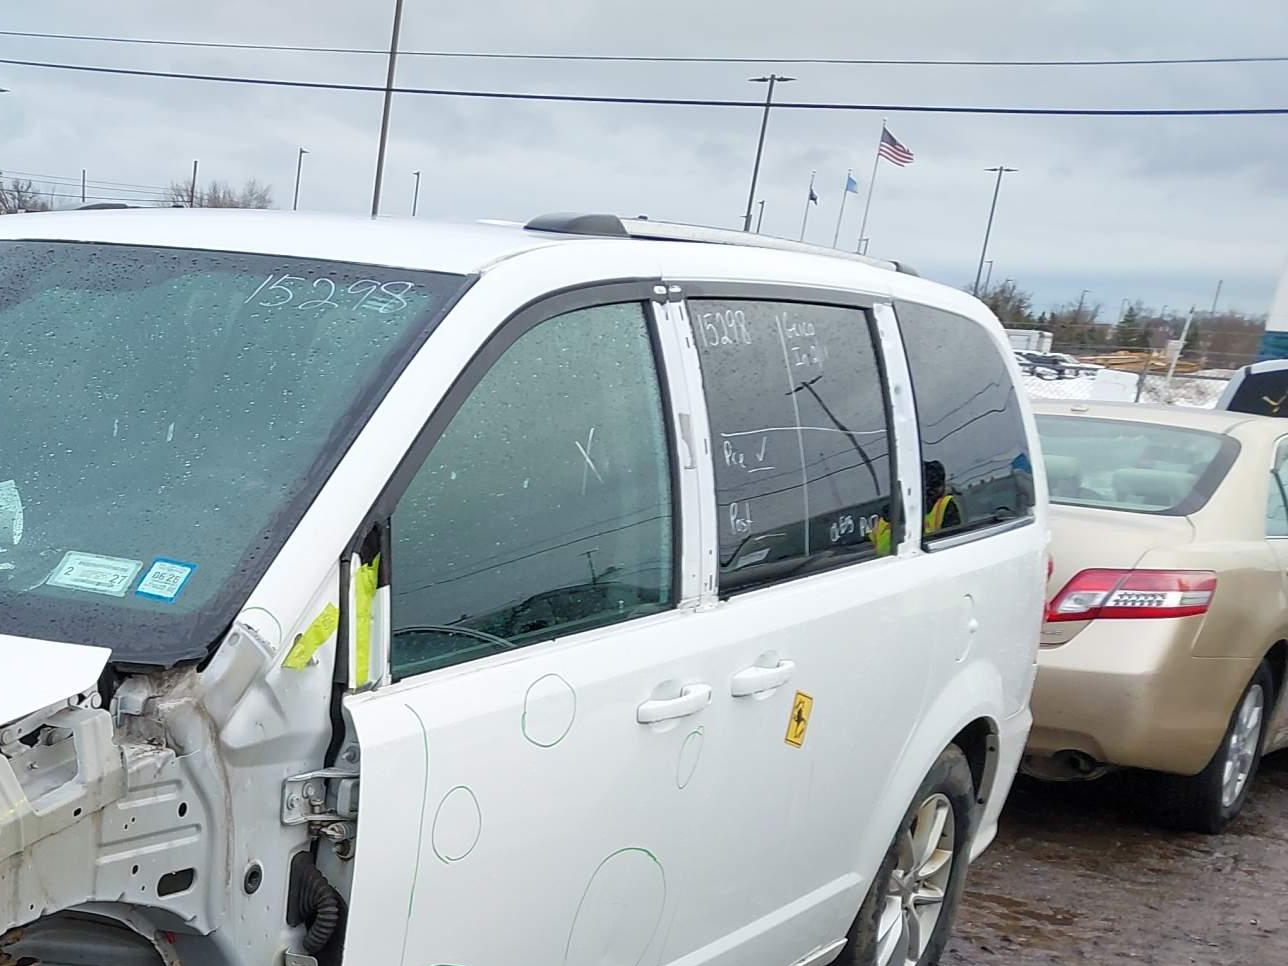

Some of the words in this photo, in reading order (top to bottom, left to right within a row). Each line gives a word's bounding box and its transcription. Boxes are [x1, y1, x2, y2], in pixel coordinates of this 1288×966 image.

[244, 274, 414, 314] 15298
[697, 310, 752, 347] 15298
[64, 566, 74, 576] 2
[109, 573, 128, 585] 27
